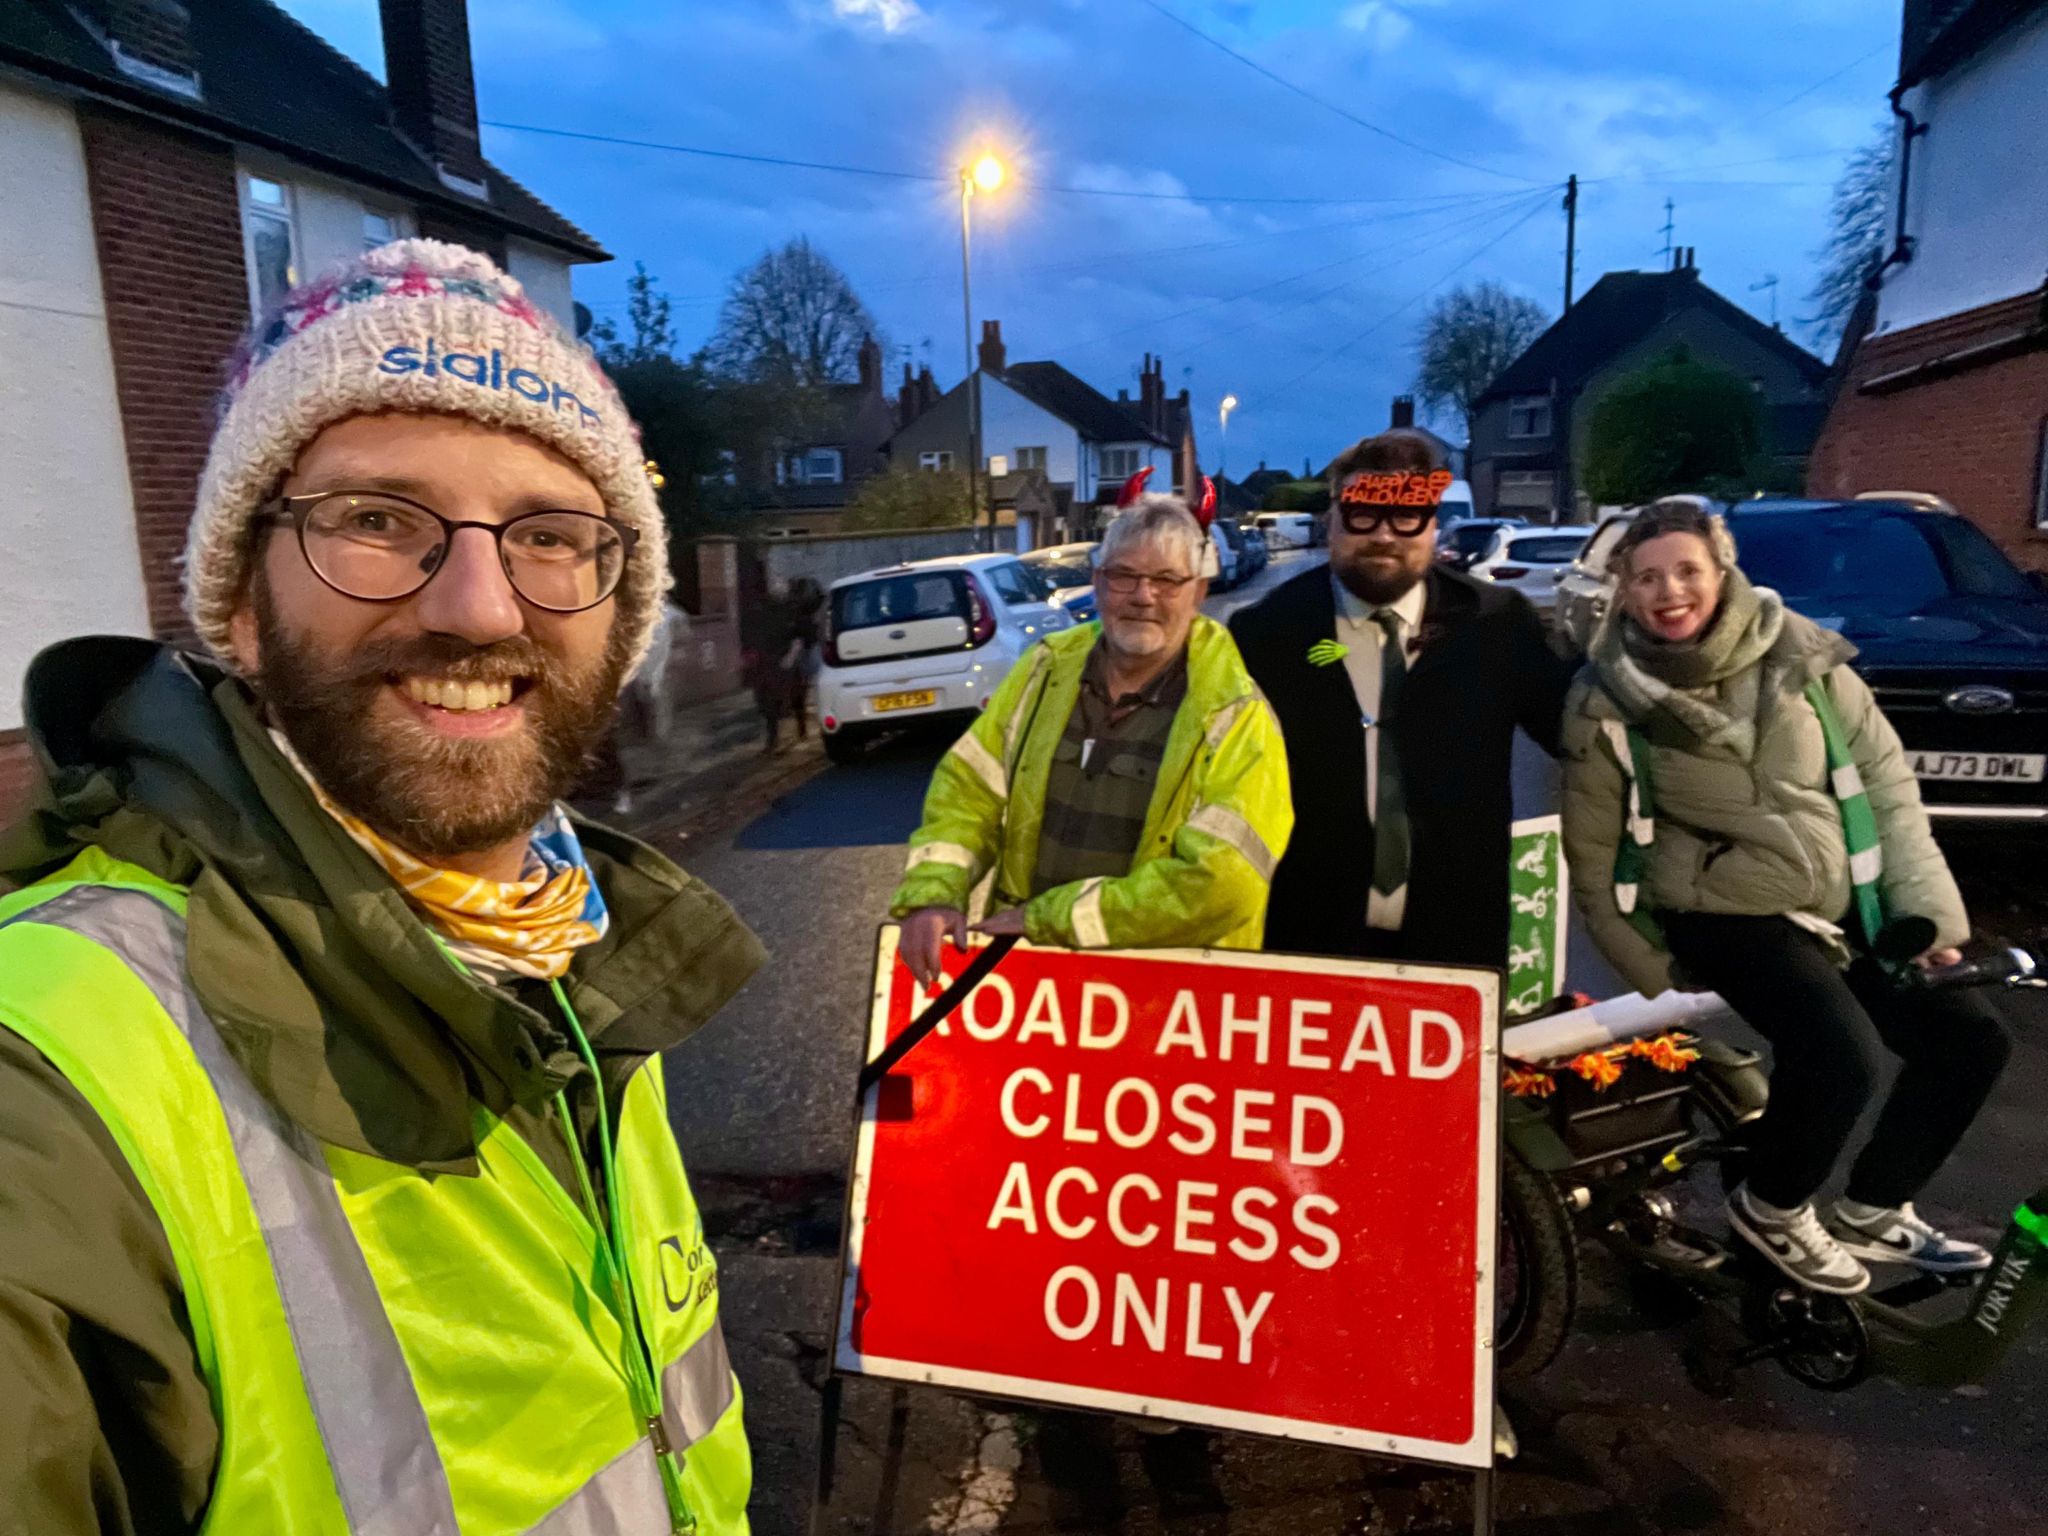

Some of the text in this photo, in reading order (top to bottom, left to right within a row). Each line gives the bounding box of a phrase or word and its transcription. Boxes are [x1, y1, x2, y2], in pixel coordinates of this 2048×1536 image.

[1342, 486, 1441, 505] HALLOWEEN
[1358, 471, 1410, 490] HAPPY
[1914, 755, 2031, 778] AJ73 DWL
[1155, 989, 1465, 1080] AHEAD
[1000, 1067, 1344, 1167] CLOSED
[986, 1161, 1341, 1270] ACCESS
[1044, 1265, 1274, 1364] ONLY
